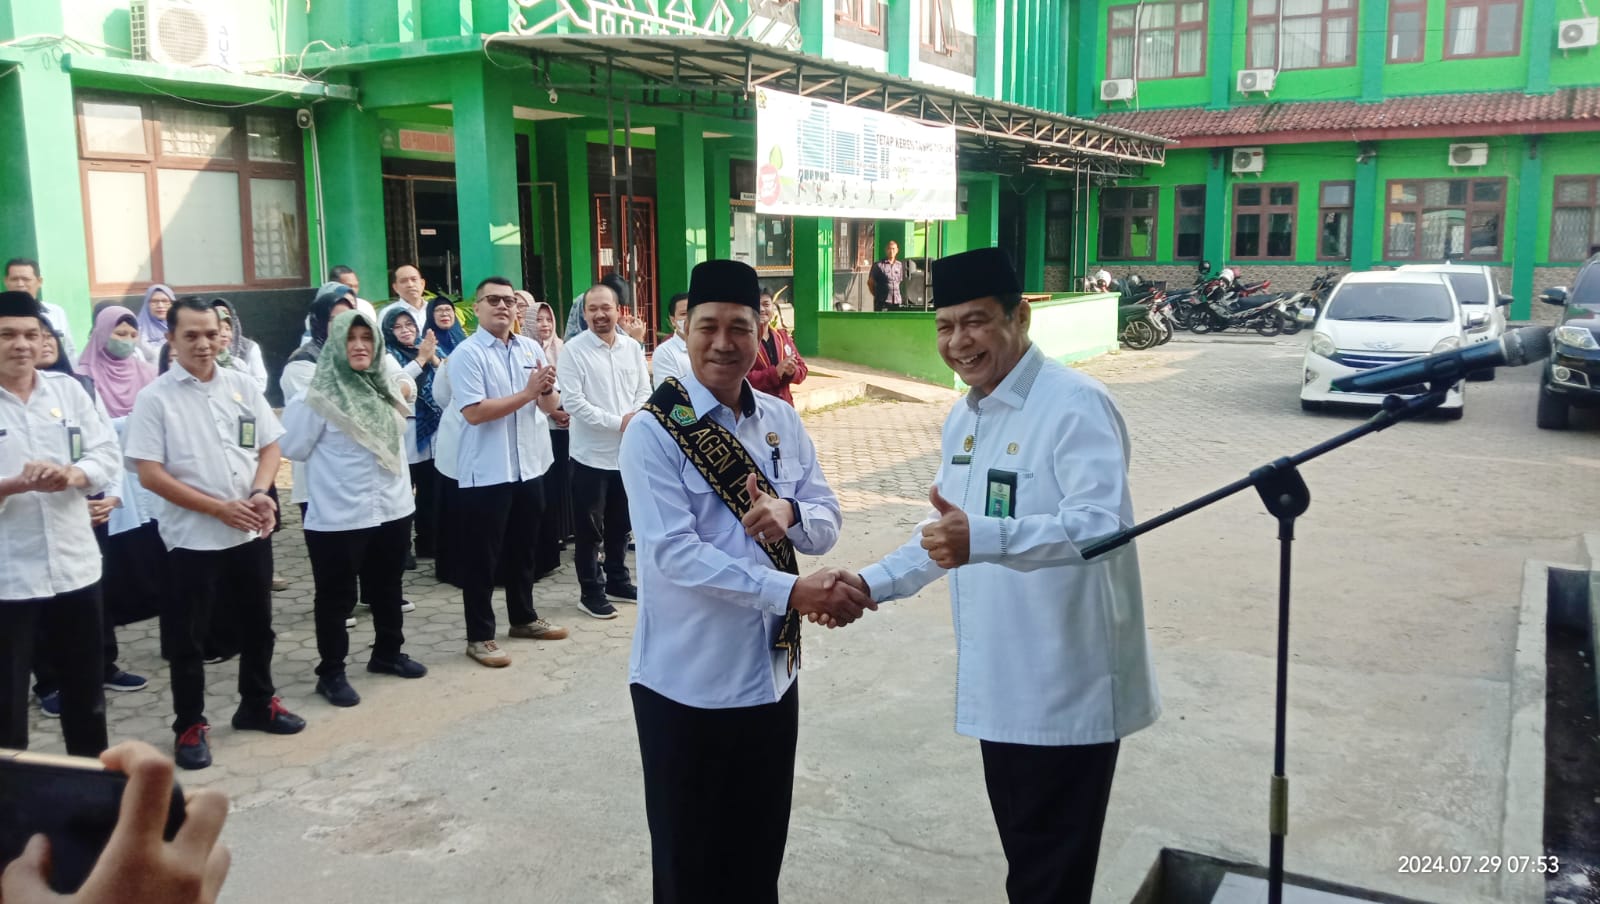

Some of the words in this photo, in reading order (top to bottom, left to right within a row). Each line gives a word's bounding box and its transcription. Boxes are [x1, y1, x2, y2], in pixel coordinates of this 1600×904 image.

[218, 25, 230, 65] AUX
[876, 134, 894, 147] TETAP
[689, 428, 737, 474] AGEN
